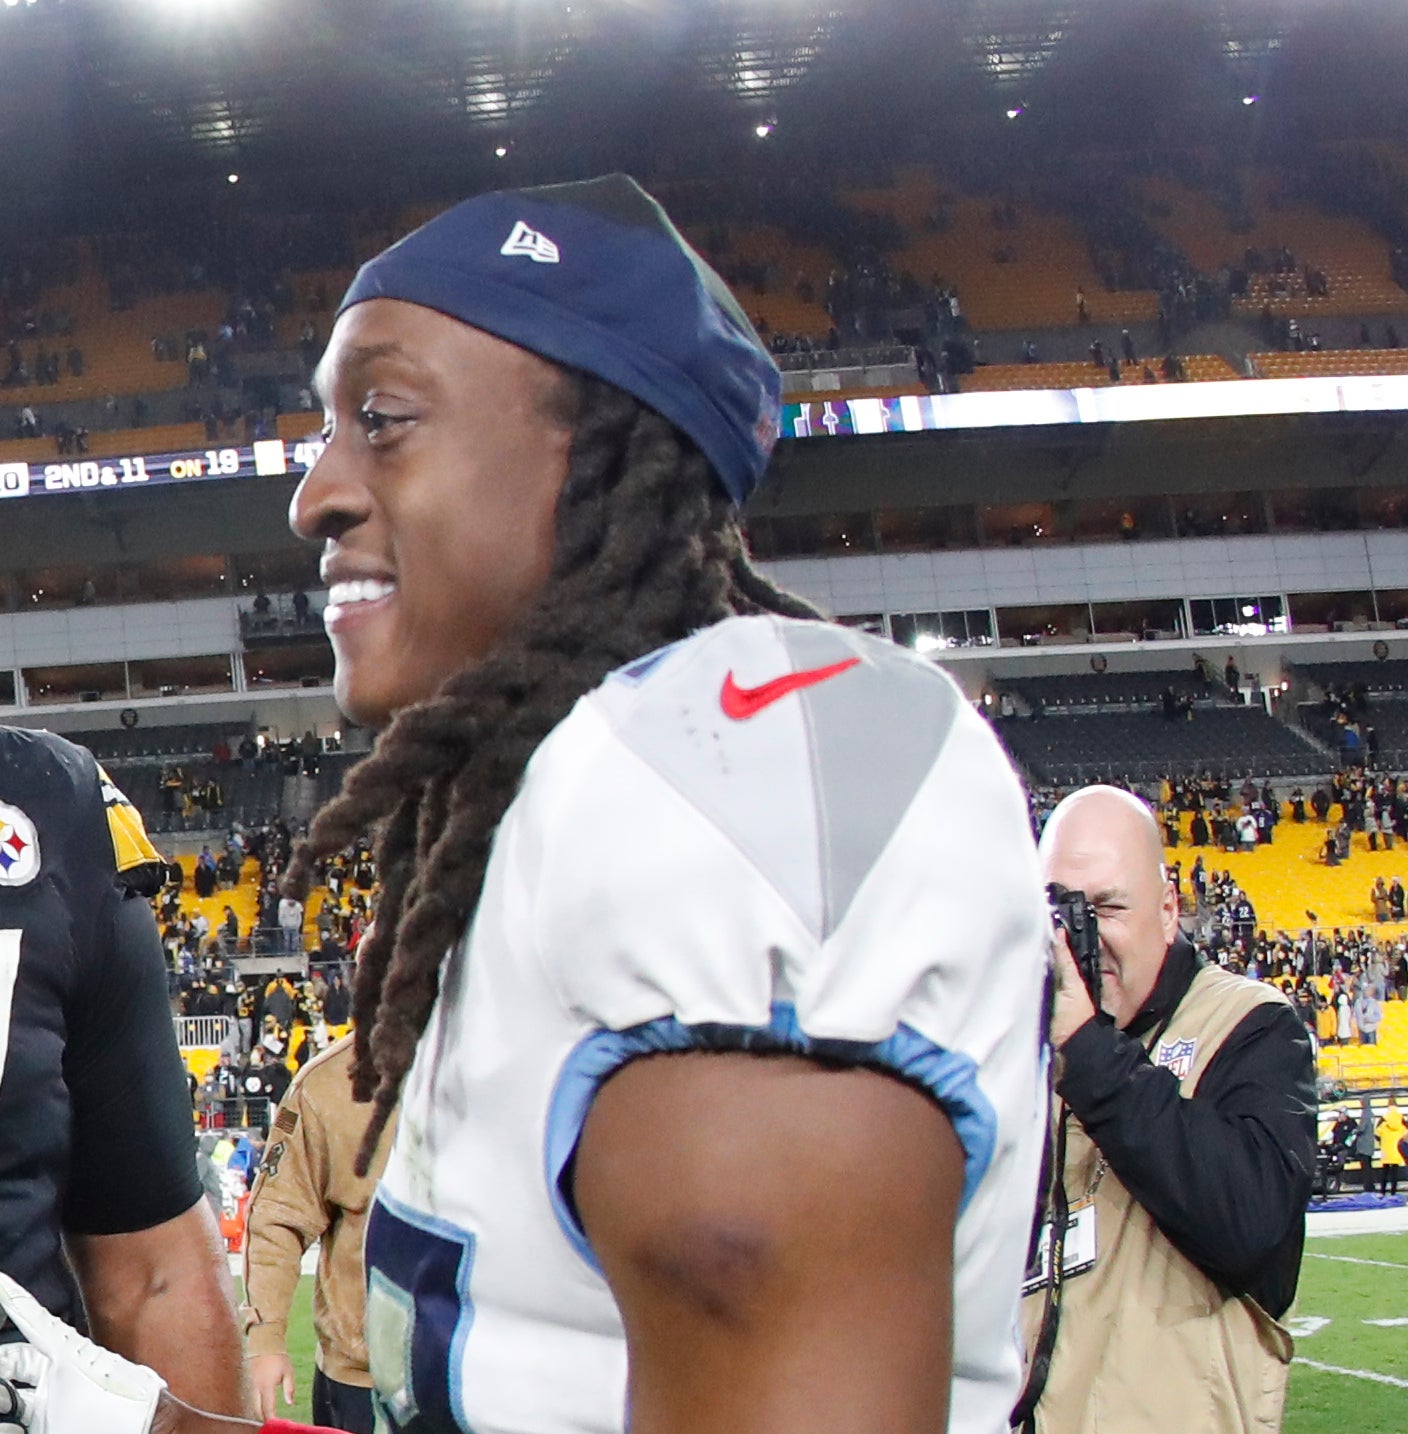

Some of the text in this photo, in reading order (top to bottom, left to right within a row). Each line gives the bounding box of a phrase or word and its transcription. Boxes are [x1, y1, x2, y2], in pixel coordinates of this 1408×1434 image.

[44, 462, 99, 489] 2ND
[119, 457, 150, 483] 11
[170, 459, 203, 479] ON
[205, 449, 239, 475] 19
